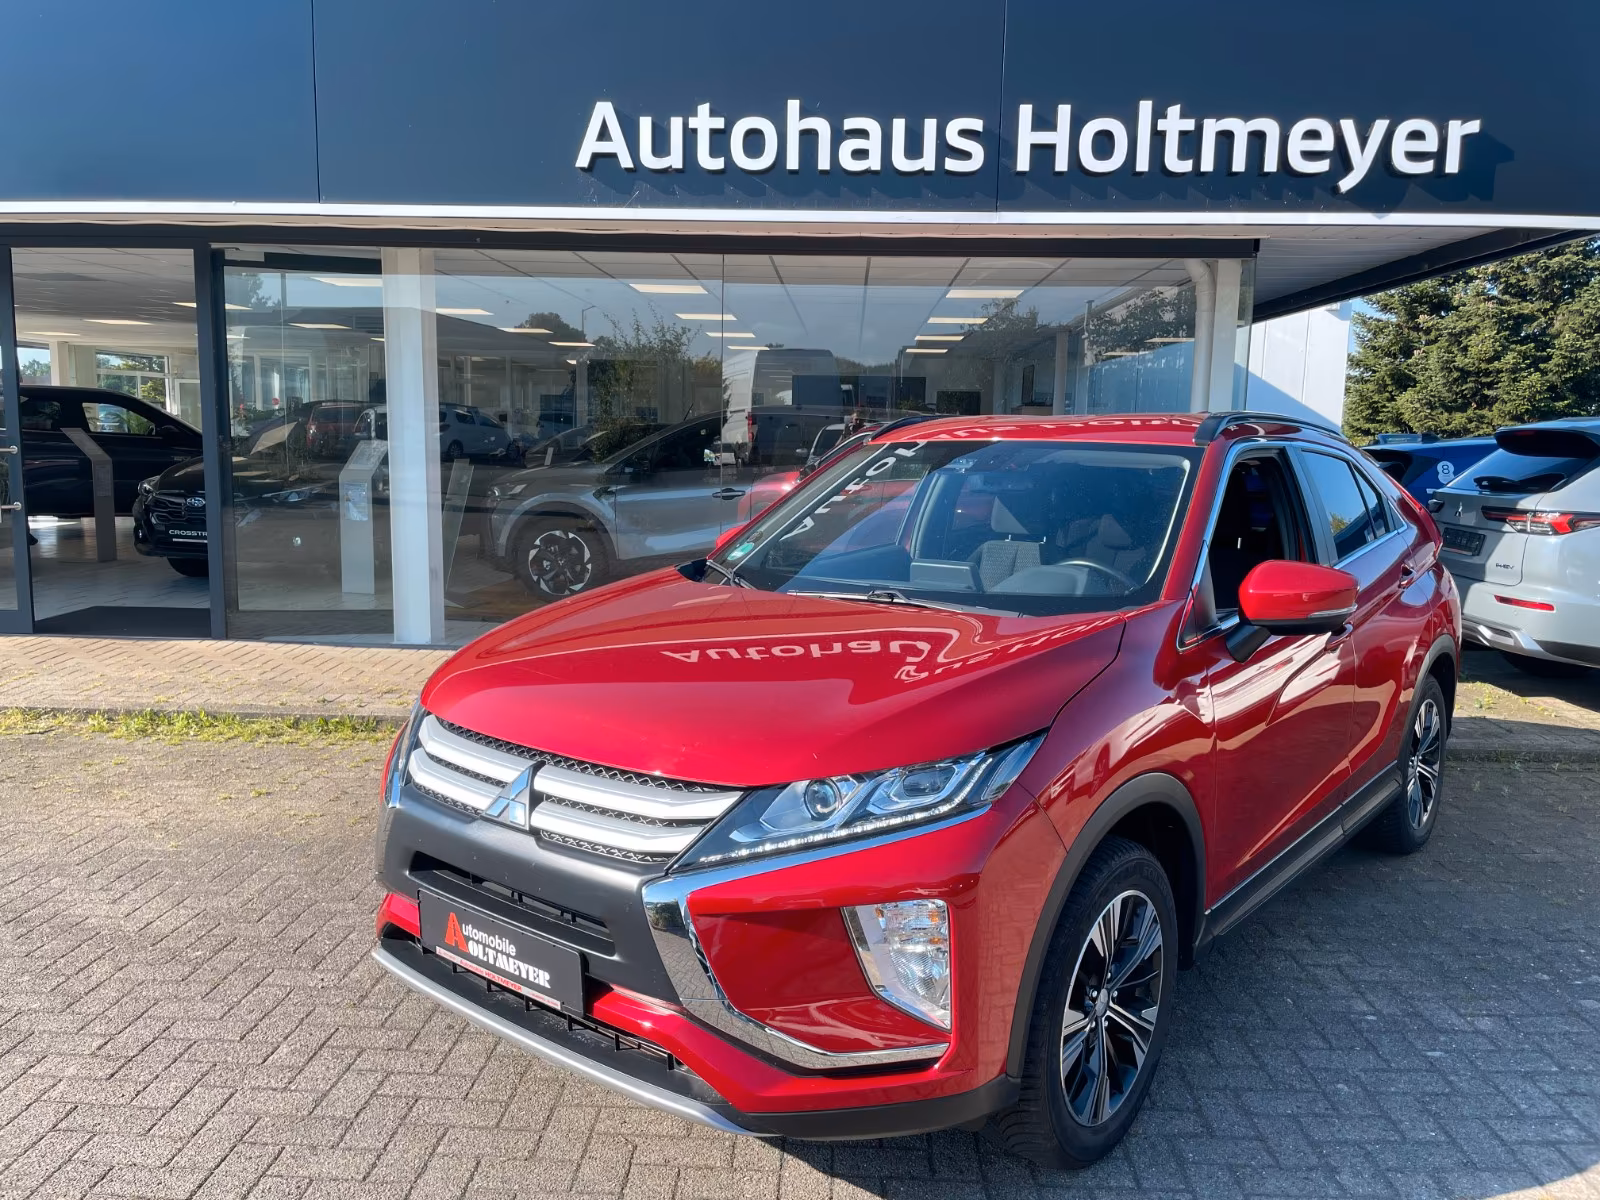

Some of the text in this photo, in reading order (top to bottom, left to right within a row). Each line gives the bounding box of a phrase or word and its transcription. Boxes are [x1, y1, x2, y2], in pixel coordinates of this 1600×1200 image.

[575, 99, 1481, 195] Autohaus Holtmeyer
[444, 912, 517, 956] Automobile
